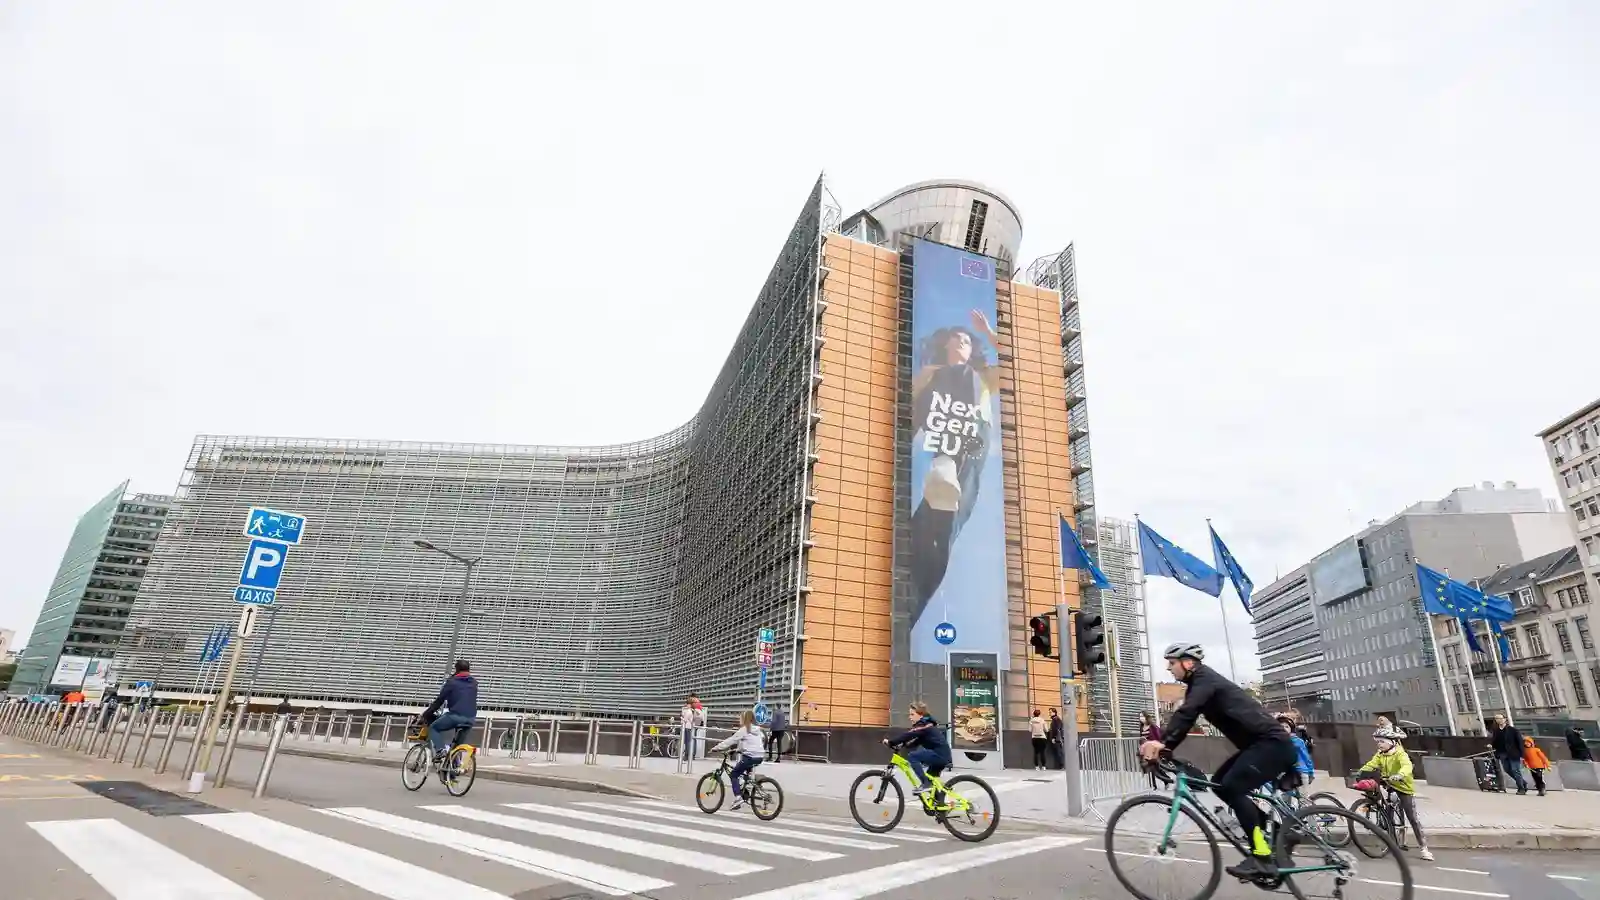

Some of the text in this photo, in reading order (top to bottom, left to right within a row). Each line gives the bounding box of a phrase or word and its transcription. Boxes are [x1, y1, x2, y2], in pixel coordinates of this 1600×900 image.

[926, 411, 978, 437] Gen
[923, 430, 961, 456] EU
[246, 546, 281, 580] P
[240, 588, 273, 603] TAXIS
